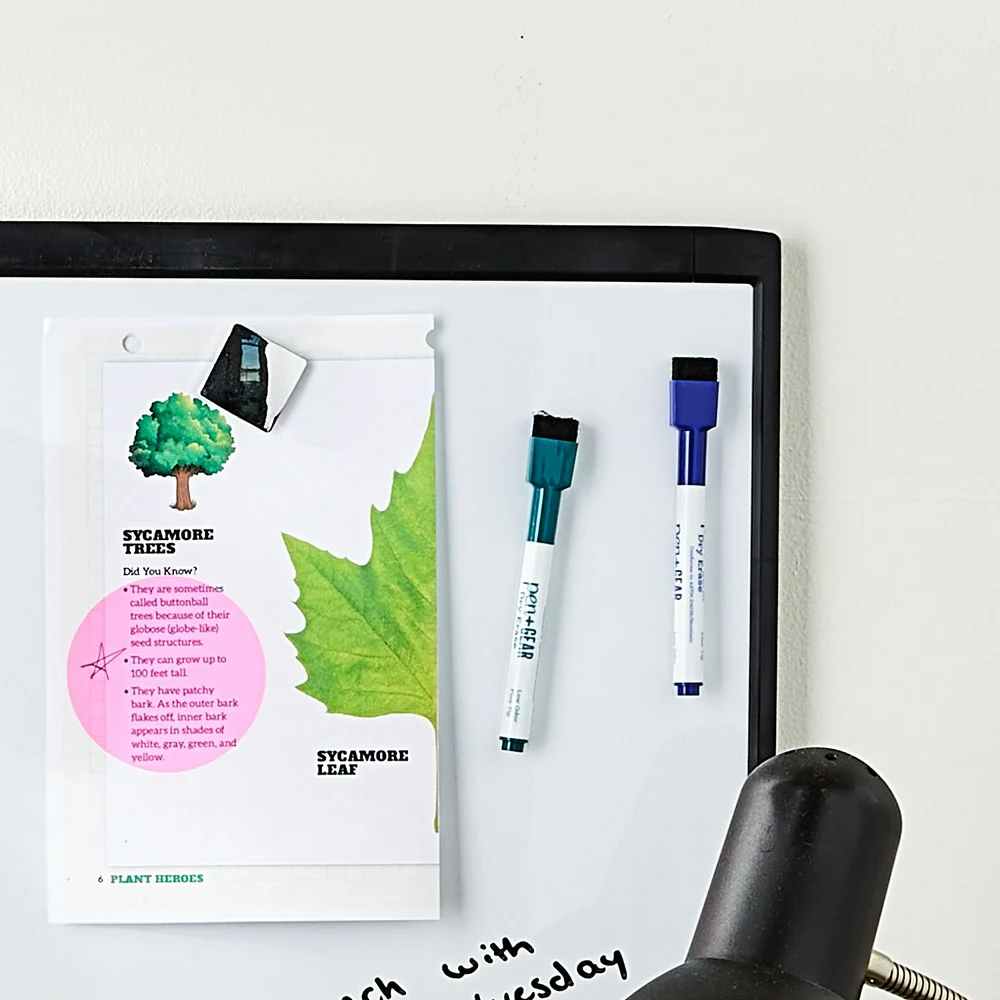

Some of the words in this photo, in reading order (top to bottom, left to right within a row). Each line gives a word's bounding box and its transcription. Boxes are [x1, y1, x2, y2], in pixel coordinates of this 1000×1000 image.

[123, 529, 214, 541] SYCAMORE
[123, 543, 176, 554] TREES
[123, 567, 140, 576] Did
[143, 567, 160, 576] You
[164, 566, 198, 575] Know?
[130, 584, 154, 594] They
[174, 584, 224, 592] sometimes
[130, 598, 158, 606] called
[160, 597, 208, 606] buttonball
[130, 612, 153, 620] trees
[156, 611, 193, 620] because
[195, 611, 204, 619] of
[208, 610, 230, 619] their
[518, 582, 539, 660] pen+GEAR
[130, 625, 166, 635] globose
[168, 624, 219, 634] (globe-like)
[130, 638, 152, 647] seed
[130, 656, 154, 666] They
[176, 657, 200, 666] grow
[202, 657, 216, 665] up
[131, 669, 148, 678] 100
[150, 669, 168, 677] feet
[131, 686, 155, 696] They
[158, 686, 180, 695] have
[183, 686, 214, 696] patchy
[158, 700, 170, 708] As
[172, 700, 187, 708] the
[189, 700, 214, 708] outer
[217, 698, 238, 707] bark
[131, 713, 158, 722] flakes
[178, 713, 202, 721] inner
[206, 712, 227, 720] bark
[131, 728, 168, 736] appears
[170, 726, 180, 734] in
[182, 726, 214, 734] shades
[216, 726, 224, 734] of
[131, 740, 161, 748] white,
[163, 741, 186, 750] gray,
[188, 741, 217, 749] green,
[219, 738, 236, 748] and
[317, 750, 408, 762] SYCAMORE
[317, 764, 357, 776] LEAF
[98, 876, 104, 884] 6
[110, 875, 152, 884] PLANT
[156, 874, 204, 883] HEROES
[442, 937, 534, 978] with
